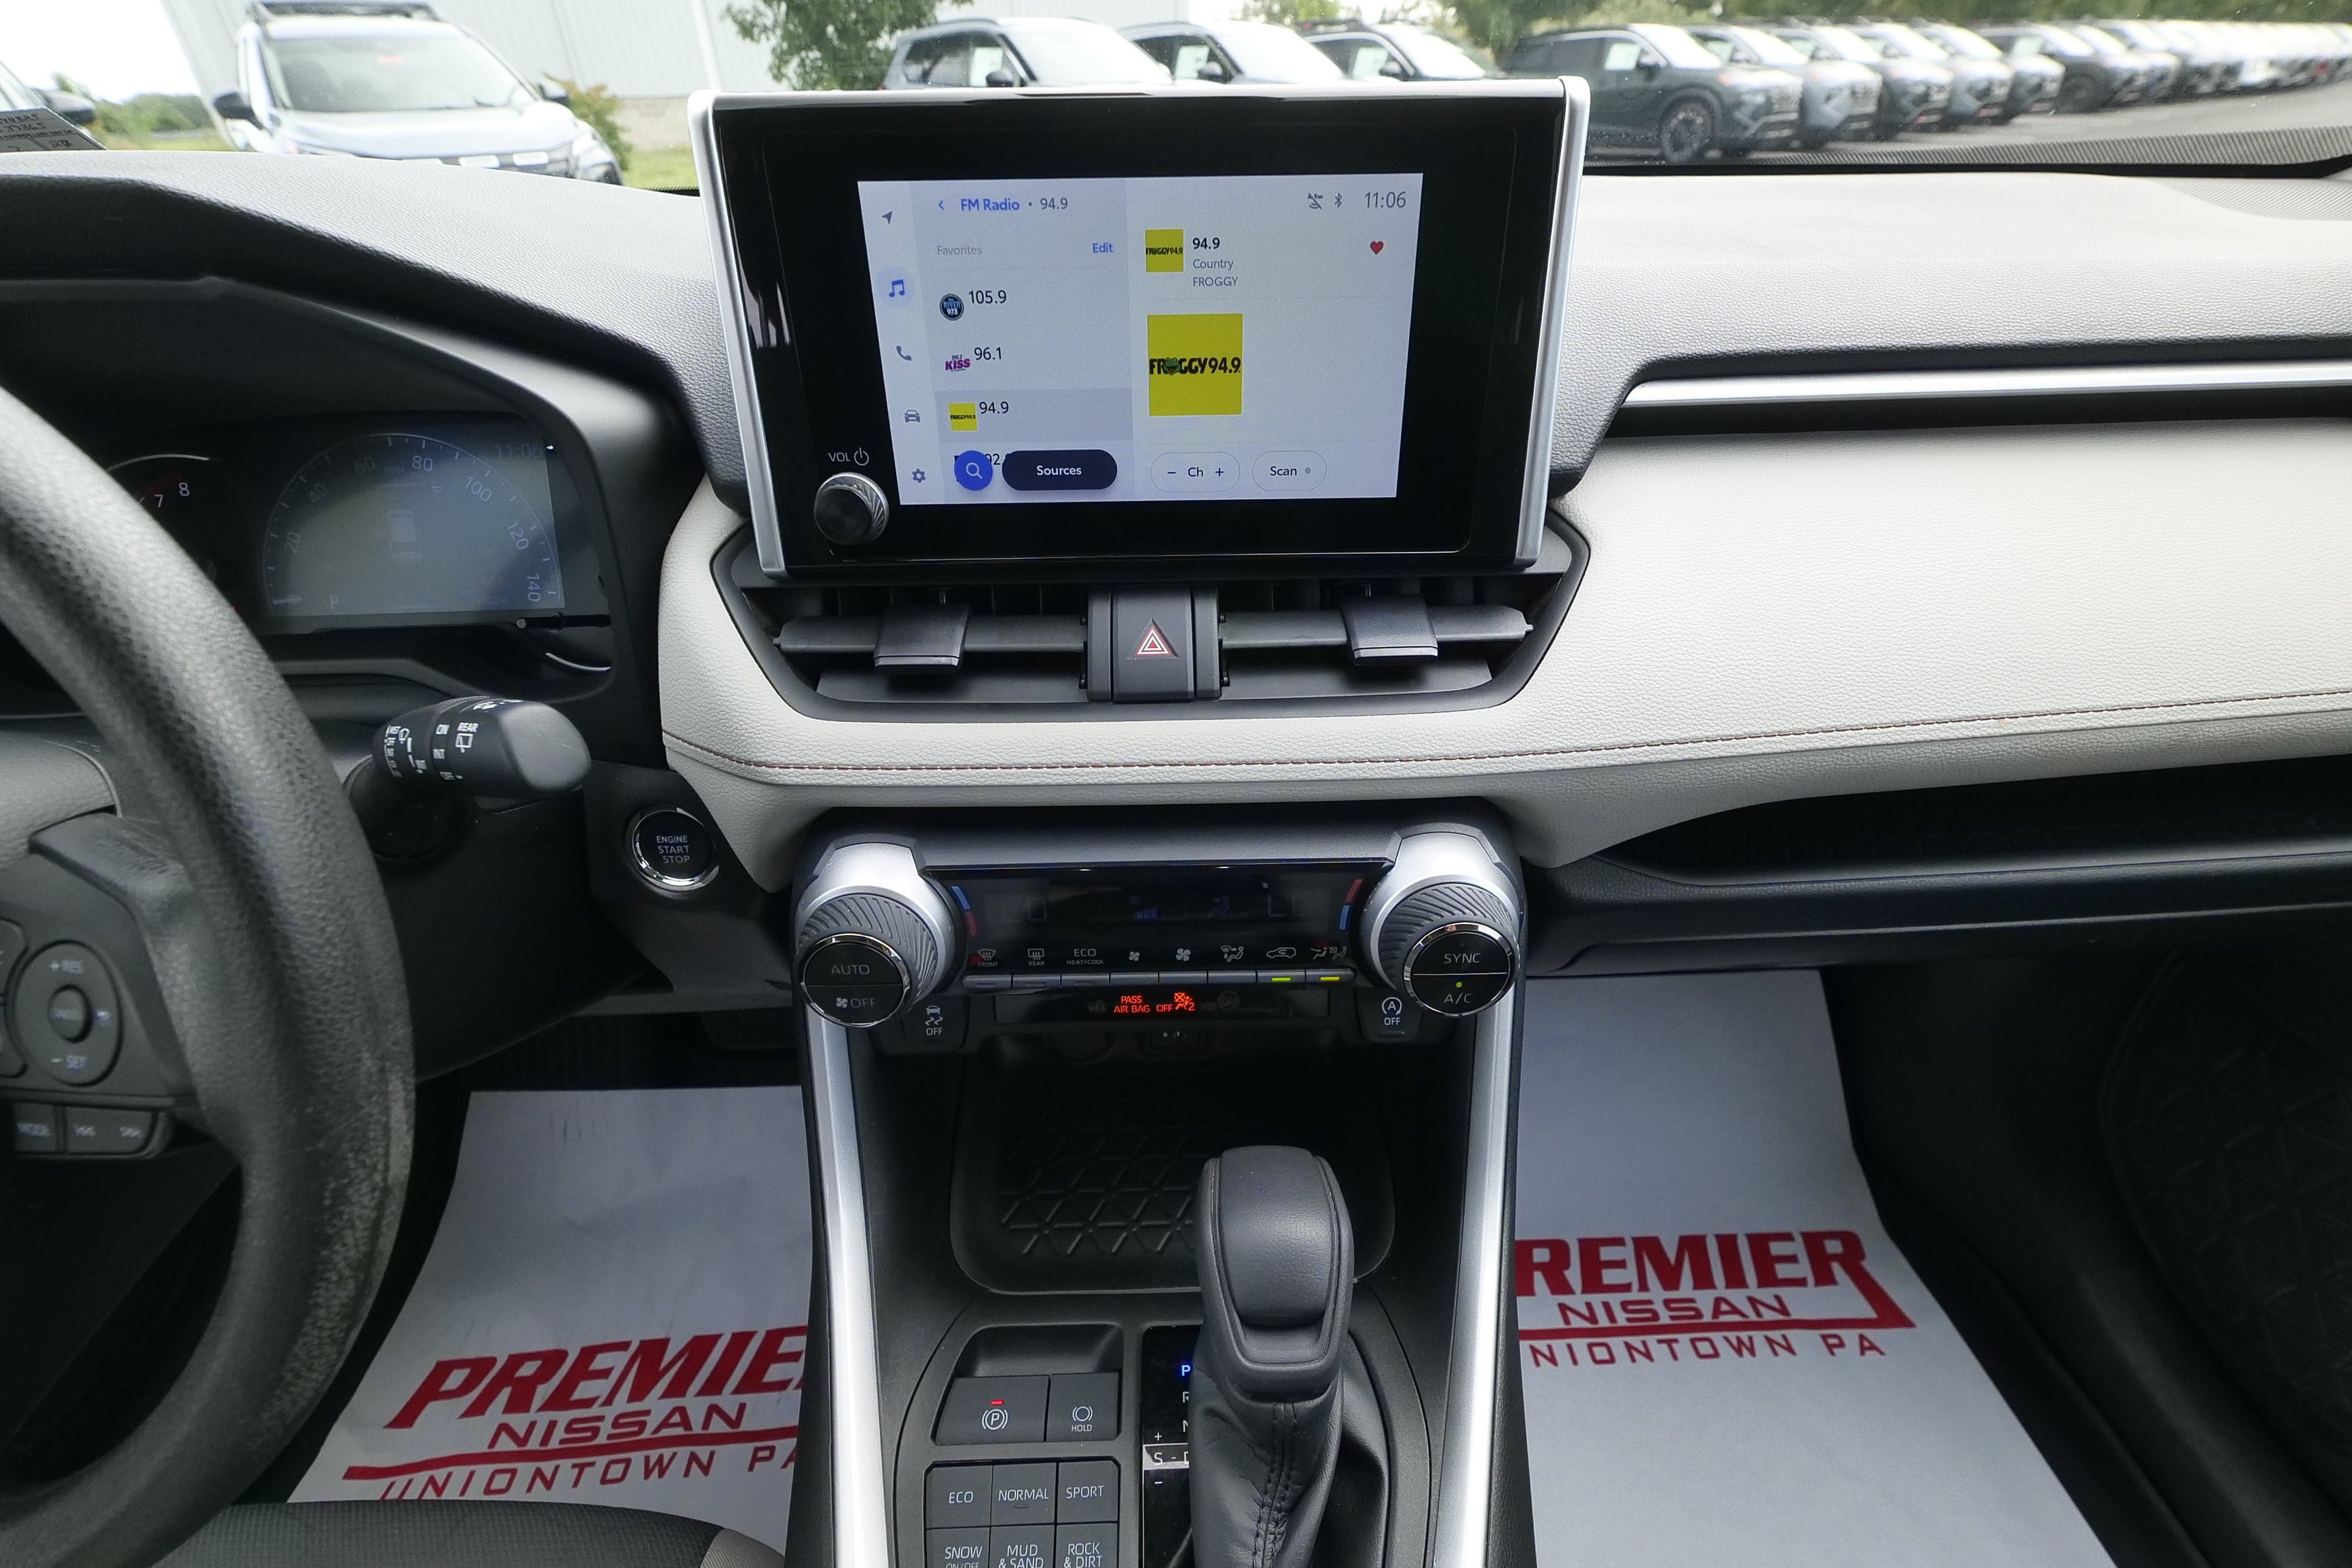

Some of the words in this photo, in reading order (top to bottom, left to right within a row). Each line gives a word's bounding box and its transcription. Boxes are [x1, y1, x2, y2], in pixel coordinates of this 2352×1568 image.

[961, 198, 979, 211] FM
[983, 198, 1020, 211] Radio
[1040, 197, 1068, 210] 94.9
[1364, 191, 1406, 208] 11:06
[937, 244, 982, 256] Favorites
[1092, 243, 1113, 253] Edit
[1193, 238, 1220, 250] 94.9
[1193, 259, 1233, 271] Country
[1193, 276, 1238, 287] FROGGY
[969, 290, 1007, 304] 105.9
[974, 347, 1002, 360] 96.1
[945, 358, 971, 371] KISS
[979, 401, 1009, 414] 94.9
[412, 456, 433, 471] 80
[828, 452, 850, 462] VOL
[1037, 464, 1082, 476] Sources
[1188, 466, 1204, 477] Ch
[1270, 465, 1297, 476] Scan
[178, 482, 190, 496] 8
[309, 484, 328, 504] 40
[465, 476, 492, 502] 100
[153, 494, 165, 508] 7
[505, 520, 530, 550] 120
[288, 532, 300, 554] 20
[527, 574, 541, 602] 140
[458, 723, 479, 733] REAR
[656, 835, 688, 844] ENGINE
[658, 845, 690, 854] START
[663, 855, 690, 864] STOP
[1074, 948, 1096, 957] ECO
[1443, 953, 1481, 964] SYNC
[831, 963, 870, 976] AUTO
[851, 998, 876, 1009] OFF
[1121, 995, 1142, 1004] PASS
[1444, 992, 1472, 1004] A/C
[1113, 1005, 1129, 1014] AIR
[1131, 1005, 1151, 1013] BAG
[1156, 1004, 1173, 1012] OFF
[1384, 1017, 1400, 1026] OFF
[926, 1027, 942, 1036] OFF
[1558, 1294, 1791, 1326] NISSAN
[1821, 1332, 1886, 1357] PA
[382, 1325, 808, 1429] PREMIE
[1182, 1365, 1190, 1376] P
[488, 1402, 747, 1449] NISSAN
[1072, 1424, 1092, 1432] HOLD
[1154, 1452, 1163, 1465] S
[380, 1449, 716, 1500] UNIONTOWN
[948, 1491, 974, 1504] ECO
[998, 1488, 1048, 1501] NORMAL
[1066, 1485, 1104, 1498] SPORT
[945, 1546, 982, 1559] SNOW
[1007, 1544, 1038, 1557] MUD
[1068, 1542, 1100, 1556] ROCK
[1010, 1557, 1044, 1568] SAND
[1064, 1557, 1072, 1567] &
[1076, 1555, 1102, 1568] DIRT
